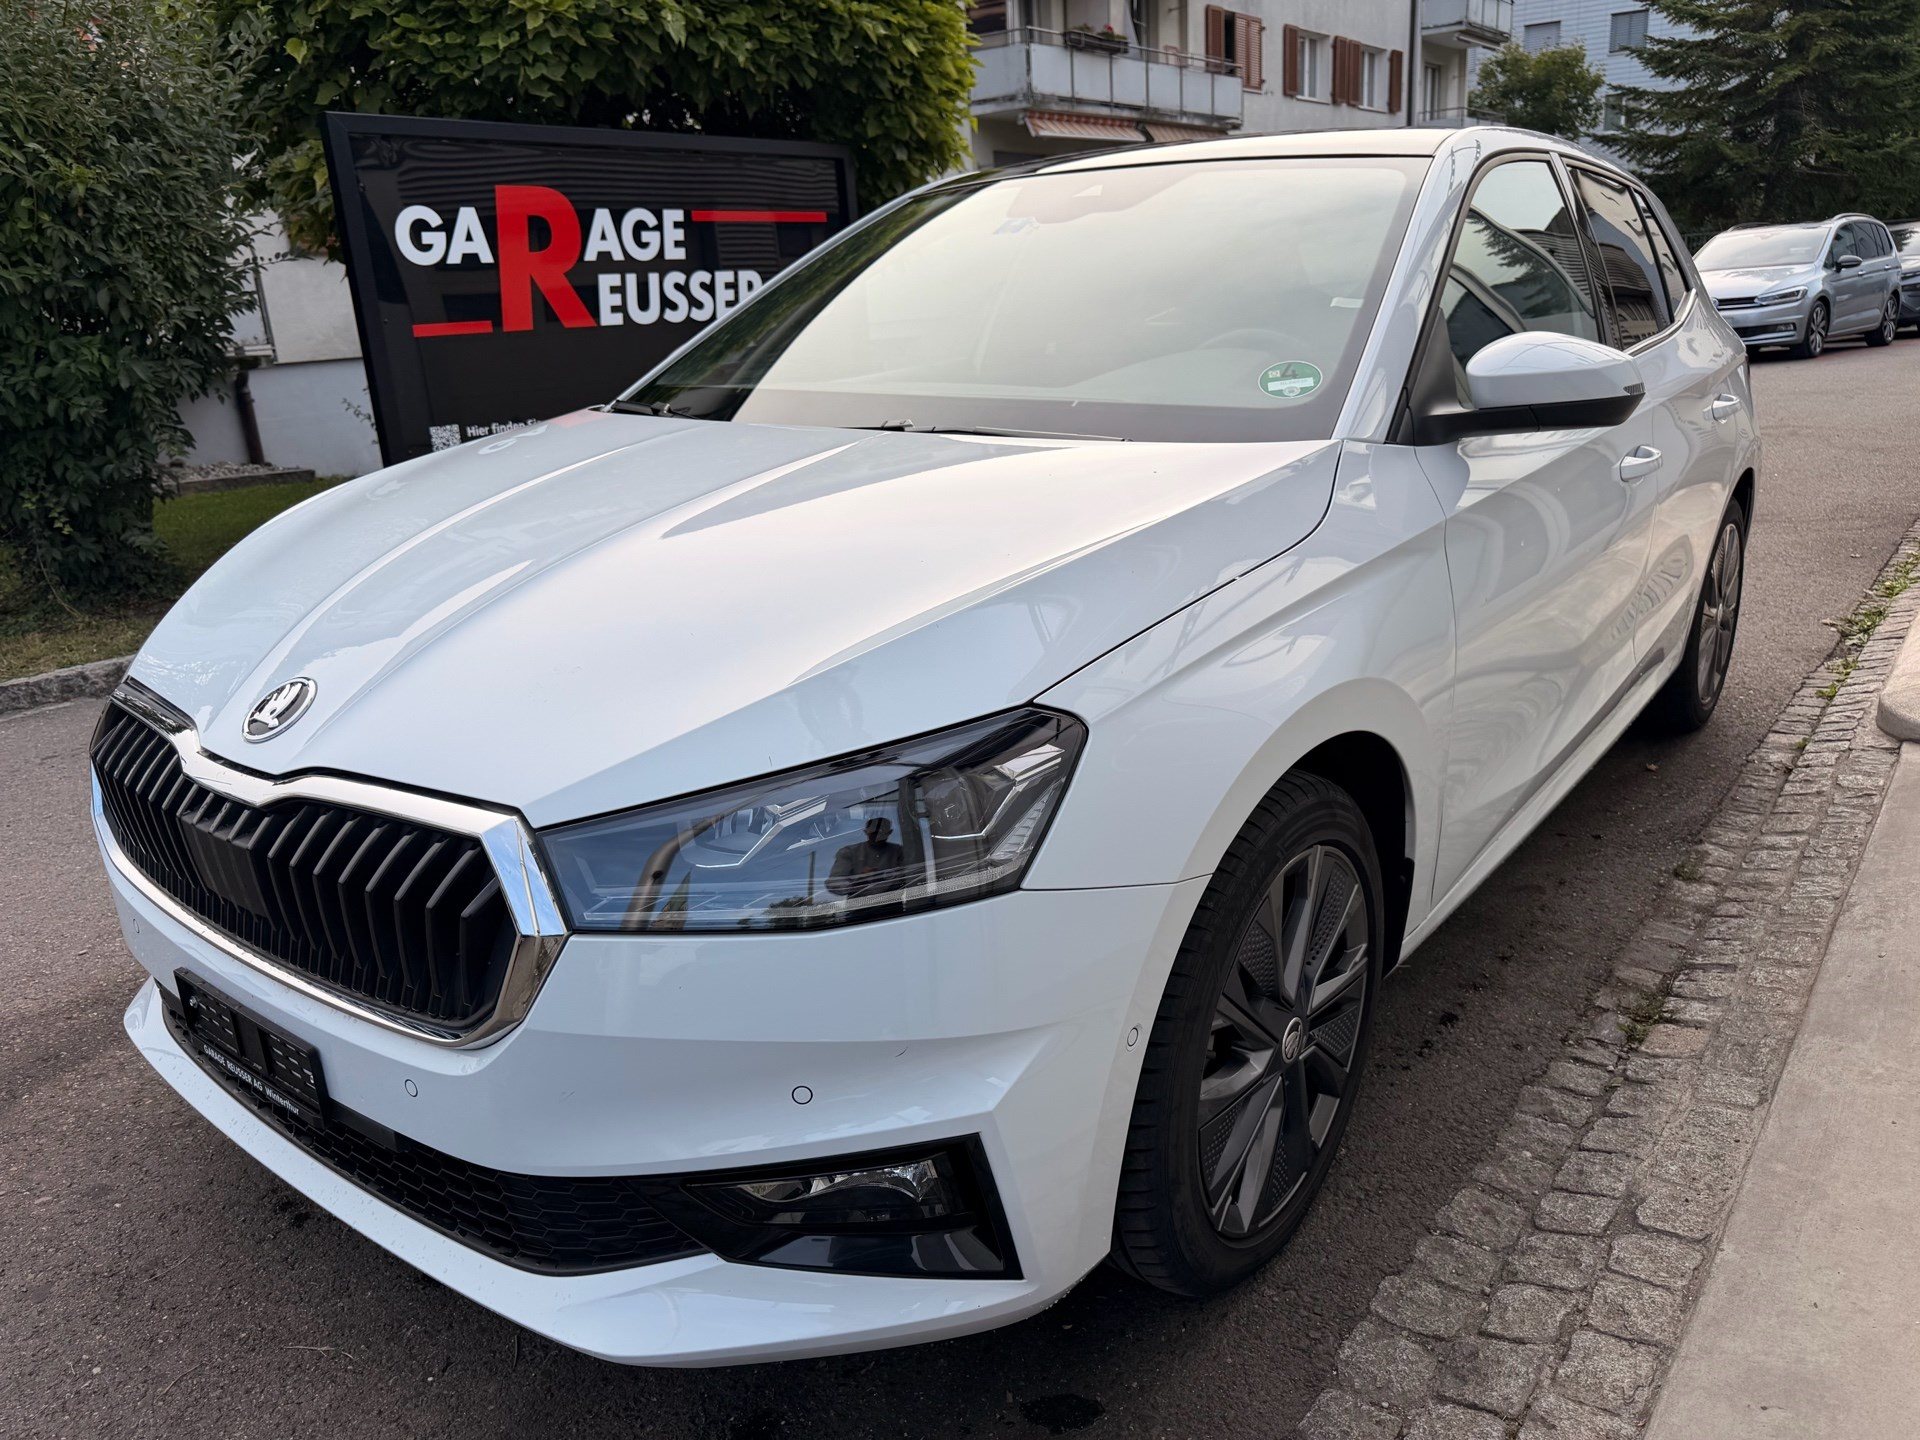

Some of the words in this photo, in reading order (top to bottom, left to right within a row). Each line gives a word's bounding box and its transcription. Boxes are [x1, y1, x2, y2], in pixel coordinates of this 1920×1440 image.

[395, 185, 686, 332] GARAGE
[467, 425, 490, 437] Hier
[204, 1044, 226, 1066] GARAGE
[226, 1060, 252, 1085] REUSSER
[253, 1078, 263, 1091] AG
